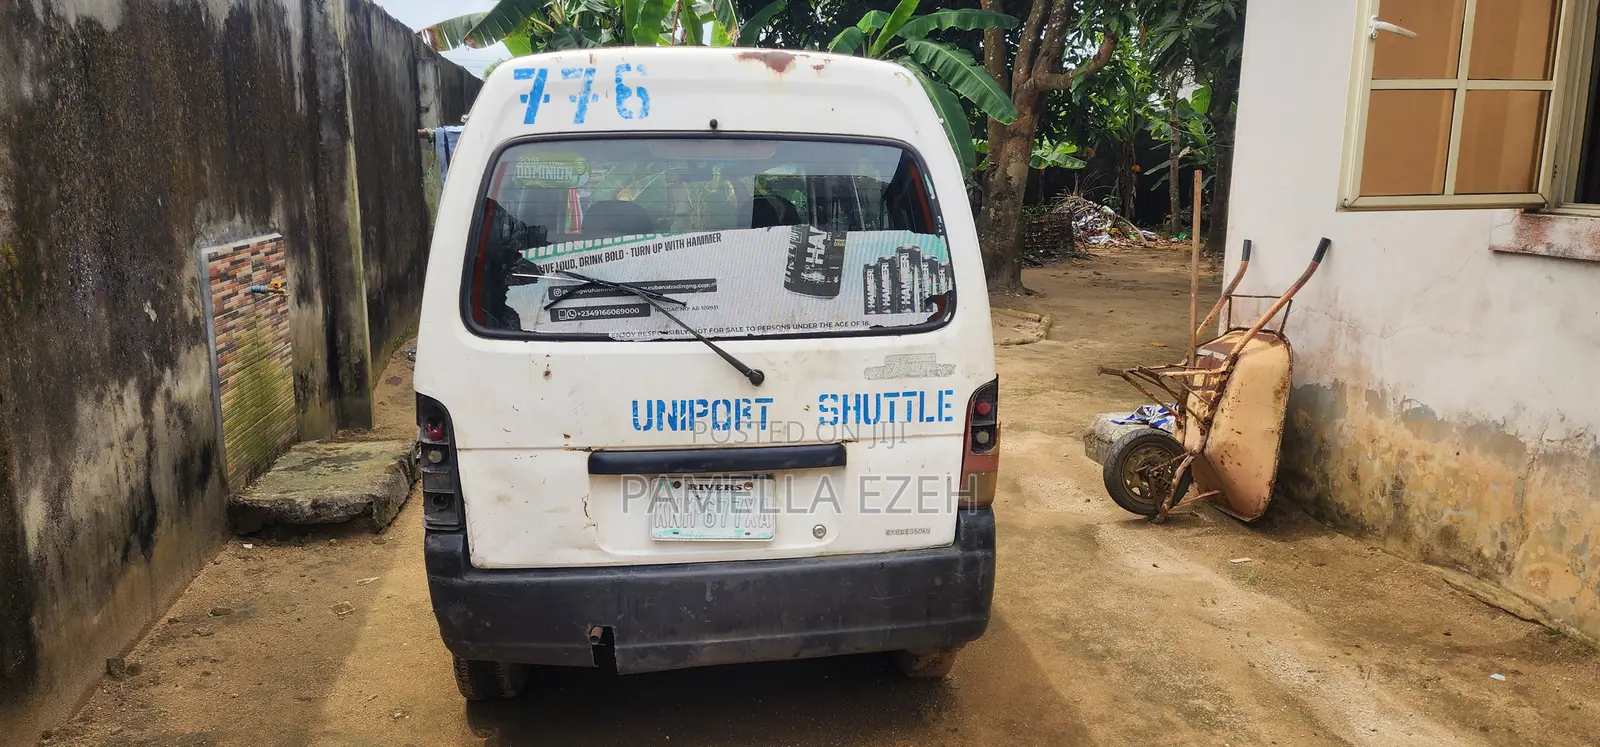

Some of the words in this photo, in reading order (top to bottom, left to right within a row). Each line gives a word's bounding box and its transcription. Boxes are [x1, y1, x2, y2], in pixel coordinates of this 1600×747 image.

[513, 63, 651, 124] 776
[579, 252, 603, 267] DRINK
[604, 249, 625, 263] BOLD
[630, 245, 651, 258] TURN
[652, 242, 663, 254] UP
[664, 239, 685, 252] WITH
[686, 232, 722, 248] HAMMER
[611, 331, 636, 339] ENJOY
[709, 326, 724, 334] FOR
[792, 322, 818, 330] UNDER
[632, 397, 774, 431] UNIPORT
[818, 389, 954, 426] SHUTTLE
[687, 483, 743, 491] RIVERS
